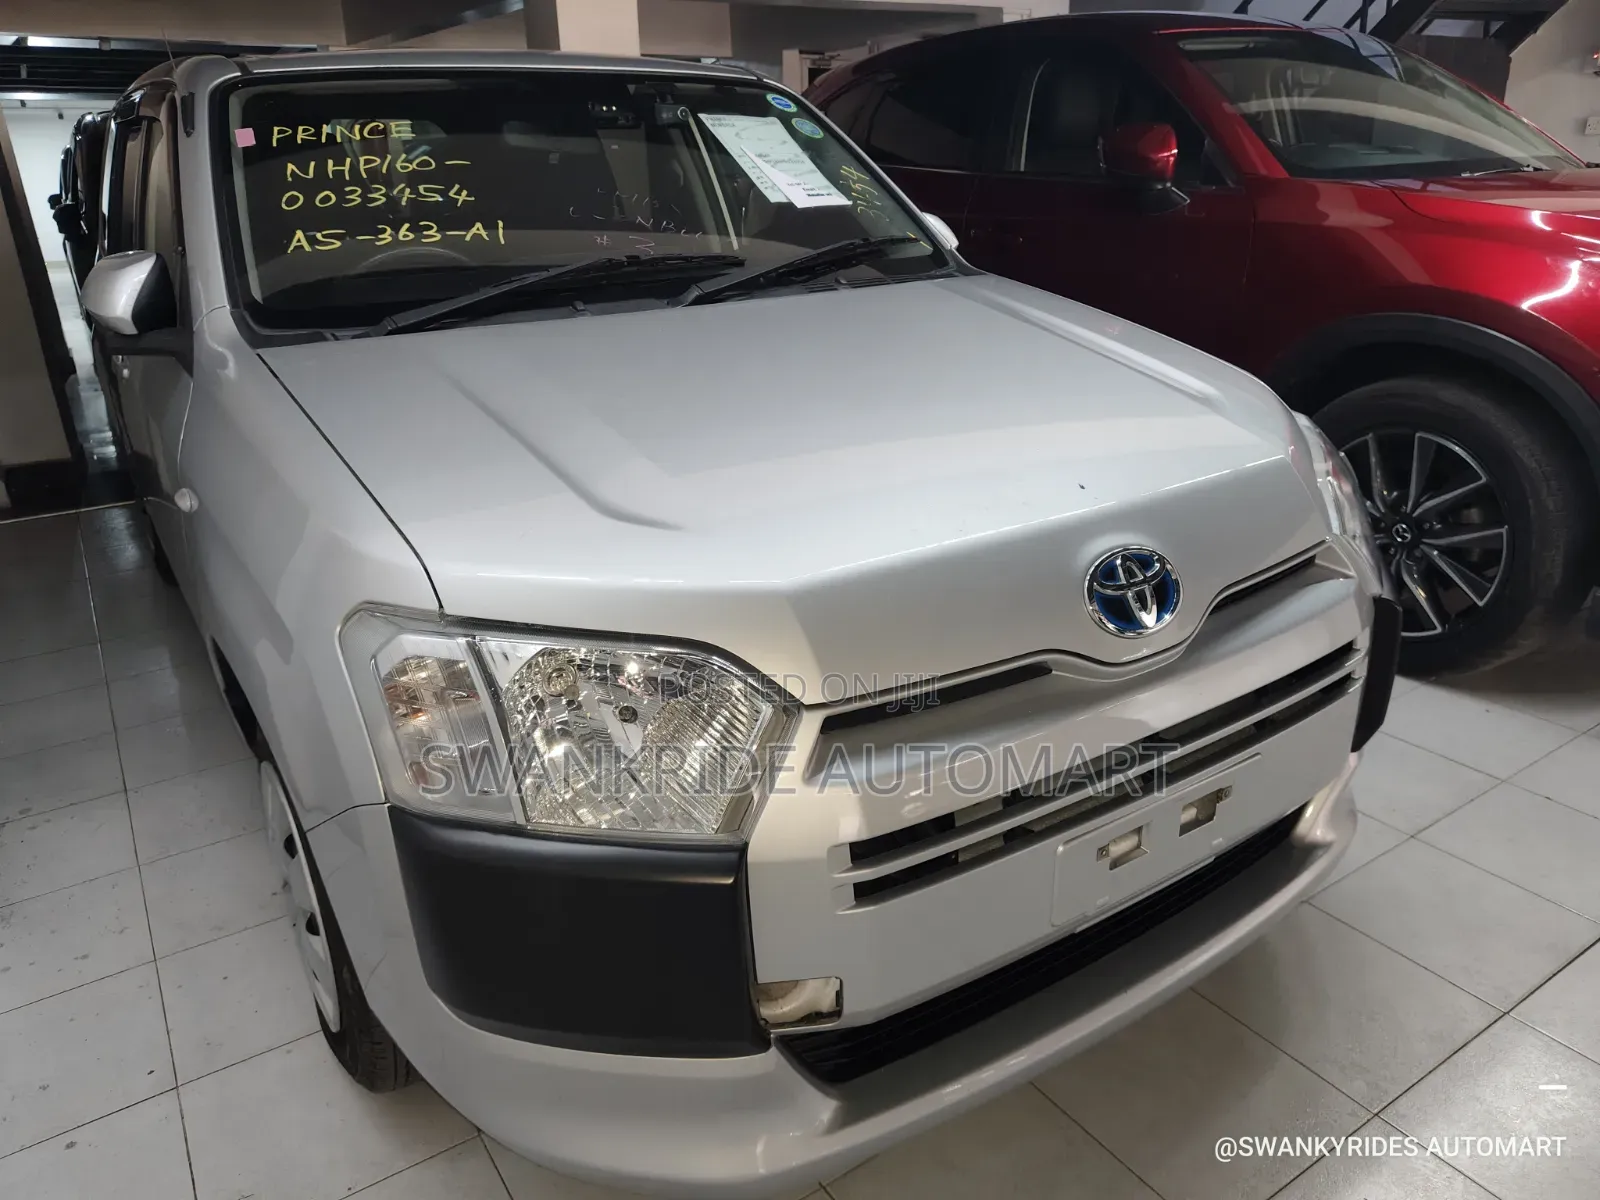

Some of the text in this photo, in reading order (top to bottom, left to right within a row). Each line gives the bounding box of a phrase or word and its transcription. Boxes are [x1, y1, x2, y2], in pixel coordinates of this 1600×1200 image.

[271, 121, 416, 147] PRINCE
[286, 154, 472, 182] NHP160-
[281, 183, 475, 210] 0033454
